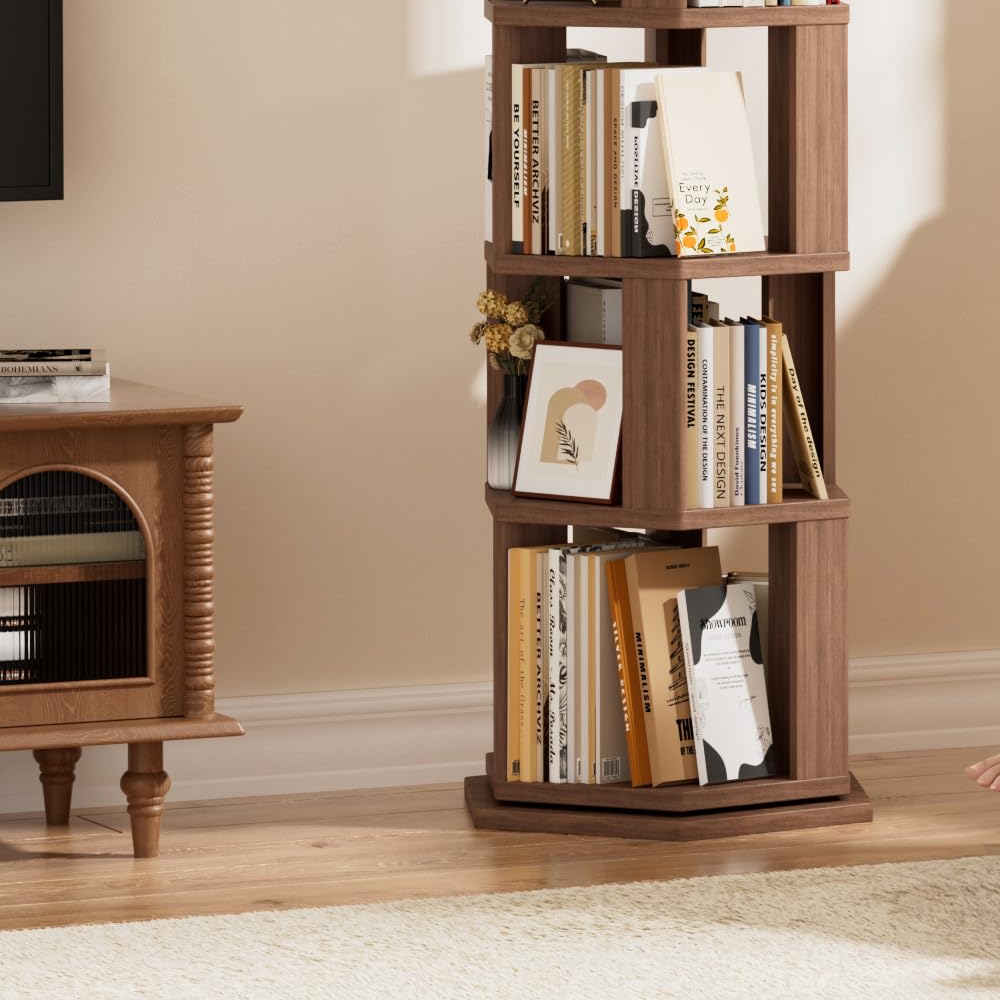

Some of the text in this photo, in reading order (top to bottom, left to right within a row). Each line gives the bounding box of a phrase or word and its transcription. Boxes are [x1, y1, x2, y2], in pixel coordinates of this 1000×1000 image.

[513, 103, 520, 123] BE
[679, 182, 711, 194] Every
[685, 194, 708, 206] Day
[687, 339, 696, 428] DESIGN FESTIVAL
[703, 424, 708, 433] OF
[747, 383, 757, 449] MINIMALISM
[788, 367, 820, 478] Day of the design
[716, 386, 726, 499] THE NEXT DESIGN
[771, 461, 777, 474] we
[635, 631, 651, 713] MINIMALISM
